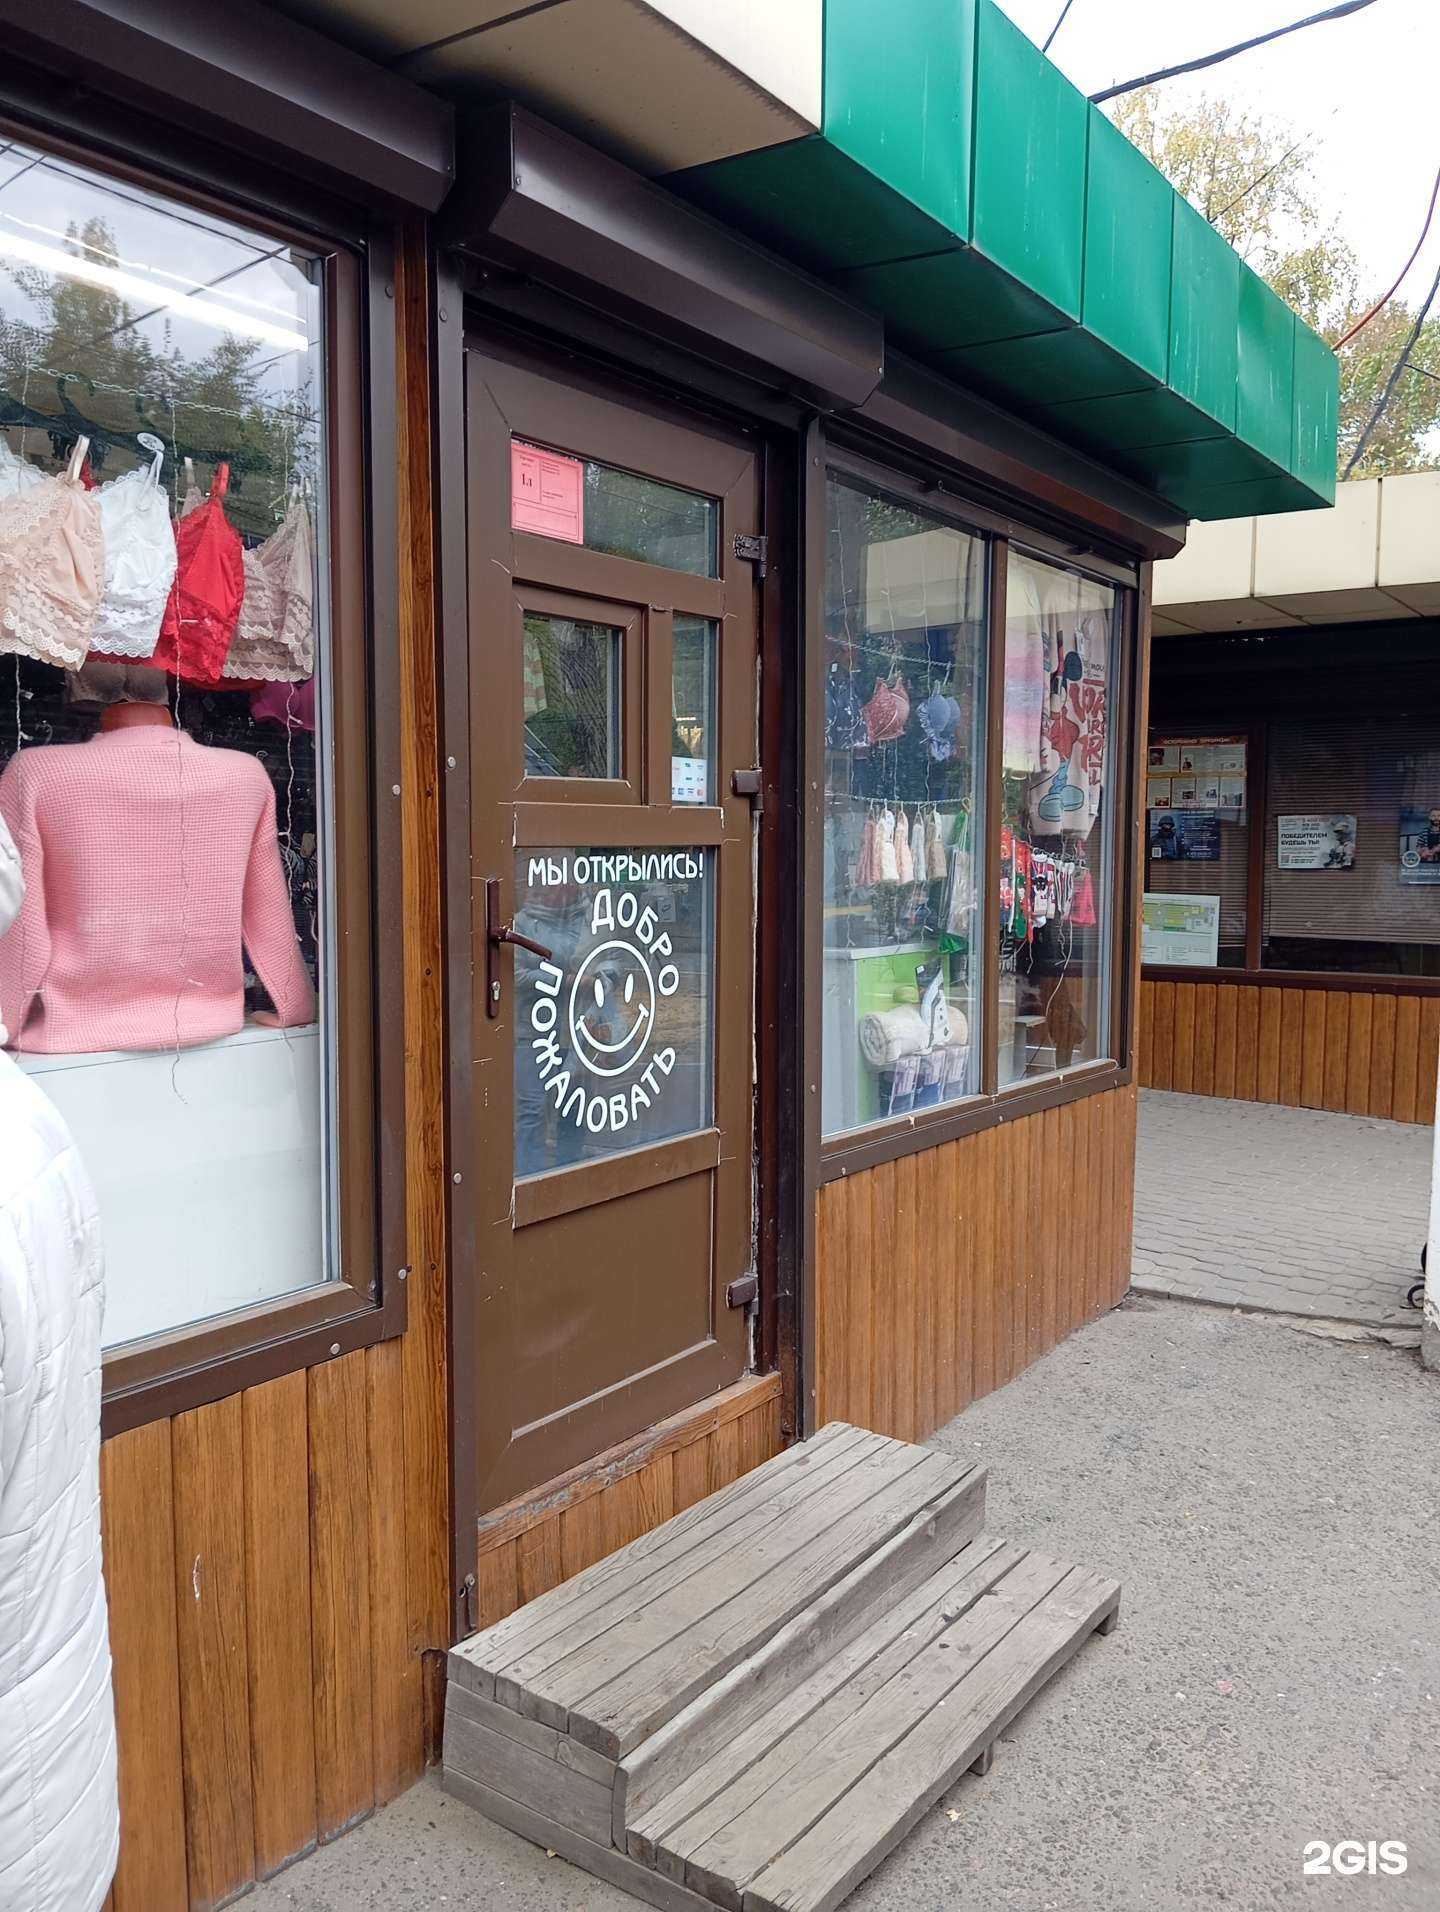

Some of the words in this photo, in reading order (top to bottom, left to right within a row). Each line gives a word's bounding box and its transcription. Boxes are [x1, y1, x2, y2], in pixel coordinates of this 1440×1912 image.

[528, 856, 567, 887] МЫ
[573, 853, 704, 885] ОТКРЫЛИСЬ!
[591, 889, 680, 996] ДОБРО
[531, 961, 677, 1133] ПОЖАЛОВАТЬ
